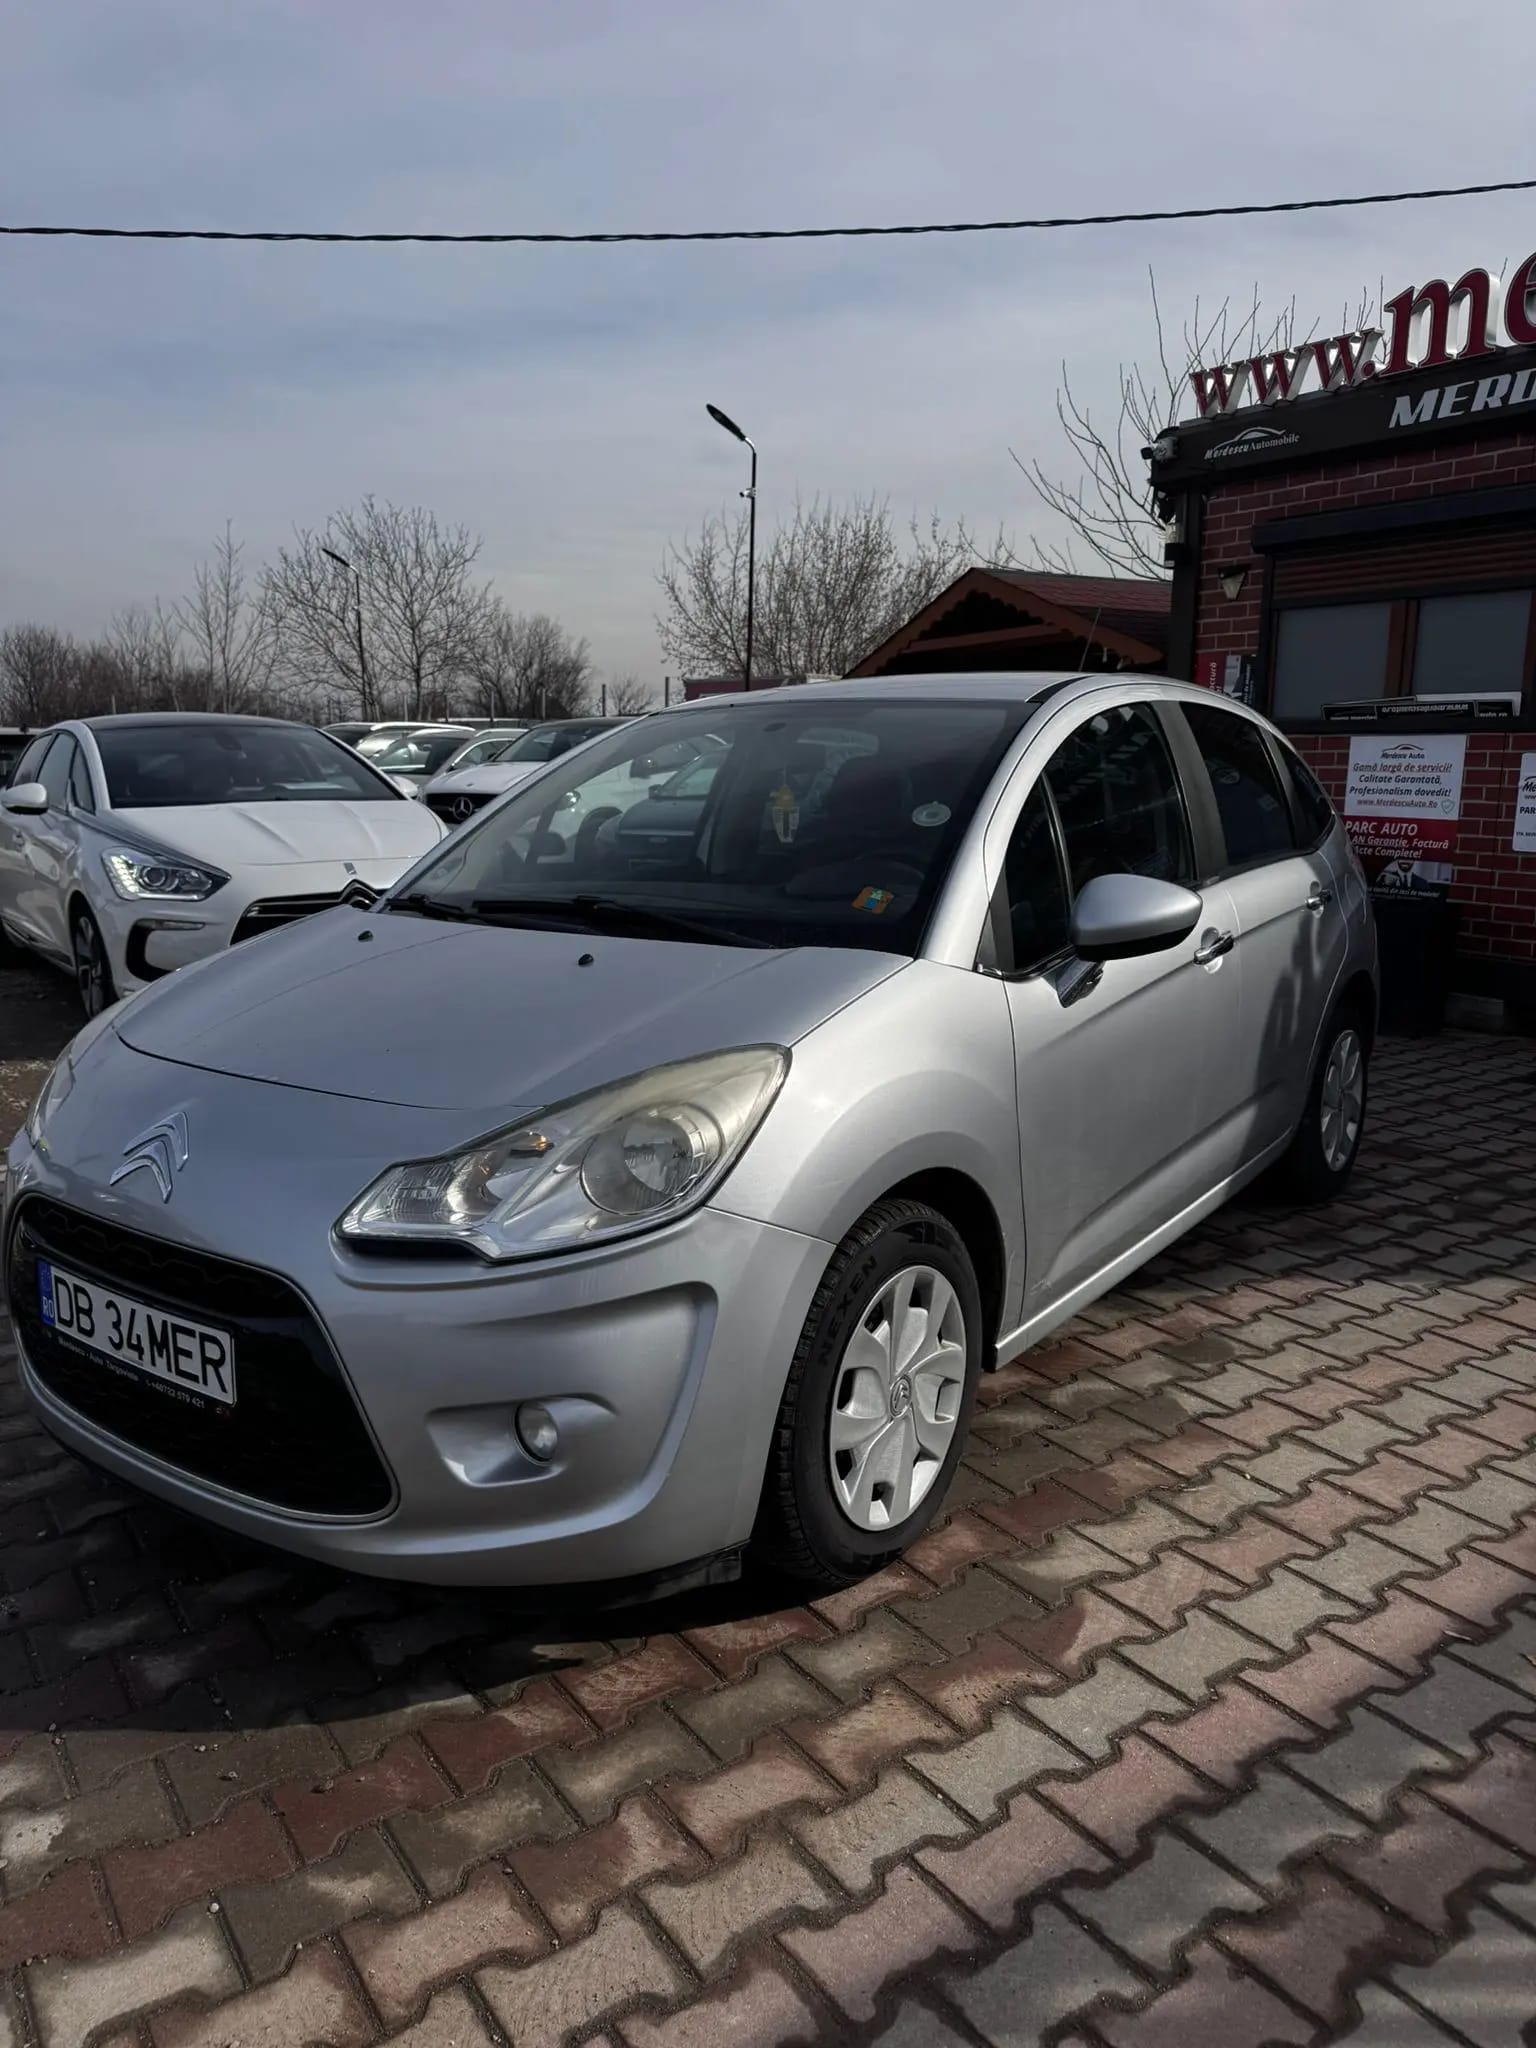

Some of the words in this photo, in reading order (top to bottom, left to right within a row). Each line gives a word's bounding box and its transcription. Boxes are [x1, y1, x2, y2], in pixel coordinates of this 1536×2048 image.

[1408, 752, 1425, 760] Auto
[1353, 762, 1377, 772] Gamă
[1378, 763, 1403, 774] largă
[1404, 764, 1416, 773] de
[1417, 763, 1453, 774] servicii!
[1359, 774, 1393, 784] Calitate
[1394, 775, 1442, 786] Garantată,
[1349, 786, 1413, 797] Profesionalism
[1414, 788, 1452, 798] dovedit!
[1344, 820, 1377, 835] PARC
[1380, 823, 1418, 836] AUTO
[1411, 838, 1450, 850] Factură
[1374, 846, 1423, 860] Complete!
[42, 1295, 54, 1319] RO
[54, 1275, 95, 1338] DB
[818, 1254, 878, 1366] NEXEN
